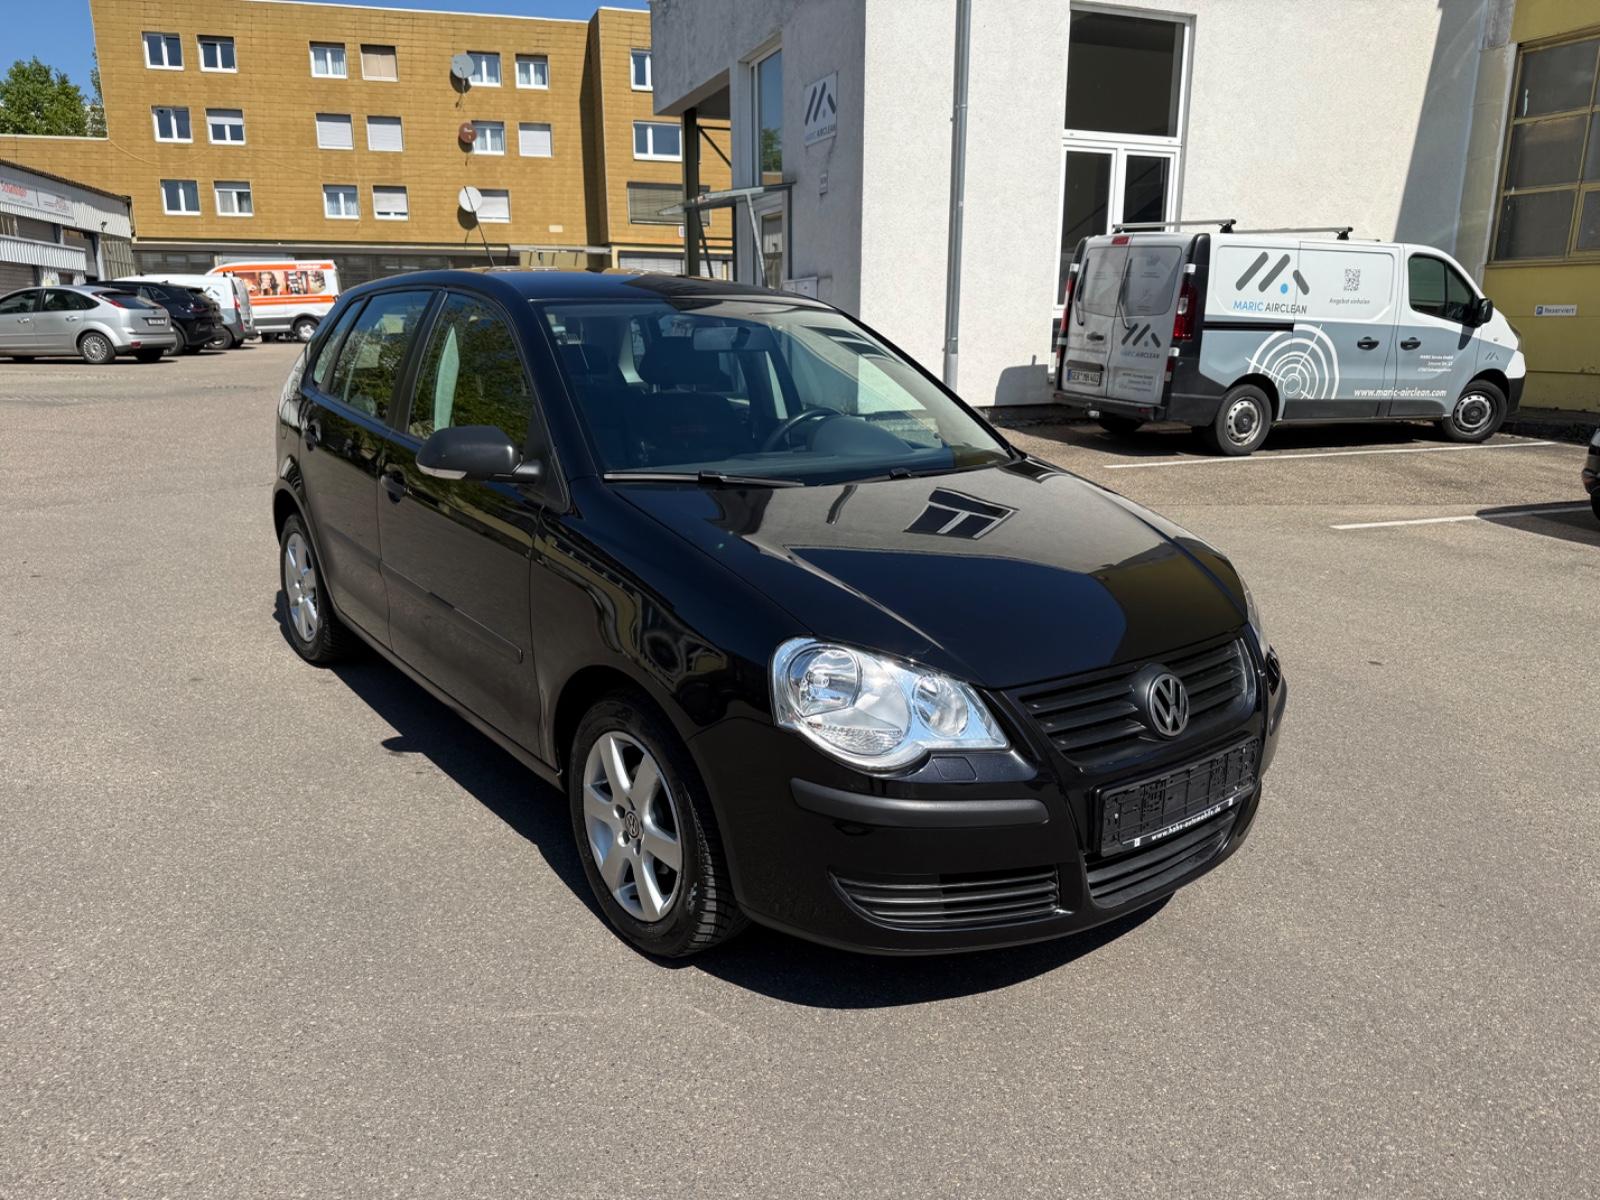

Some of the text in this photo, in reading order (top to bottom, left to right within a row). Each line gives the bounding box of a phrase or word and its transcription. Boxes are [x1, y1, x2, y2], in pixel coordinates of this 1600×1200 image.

[1233, 300, 1307, 315] MARIC AIRCLEAN
[1544, 306, 1575, 314] Reserviert
[1354, 387, 1447, 397] www.maric-airclean.com
